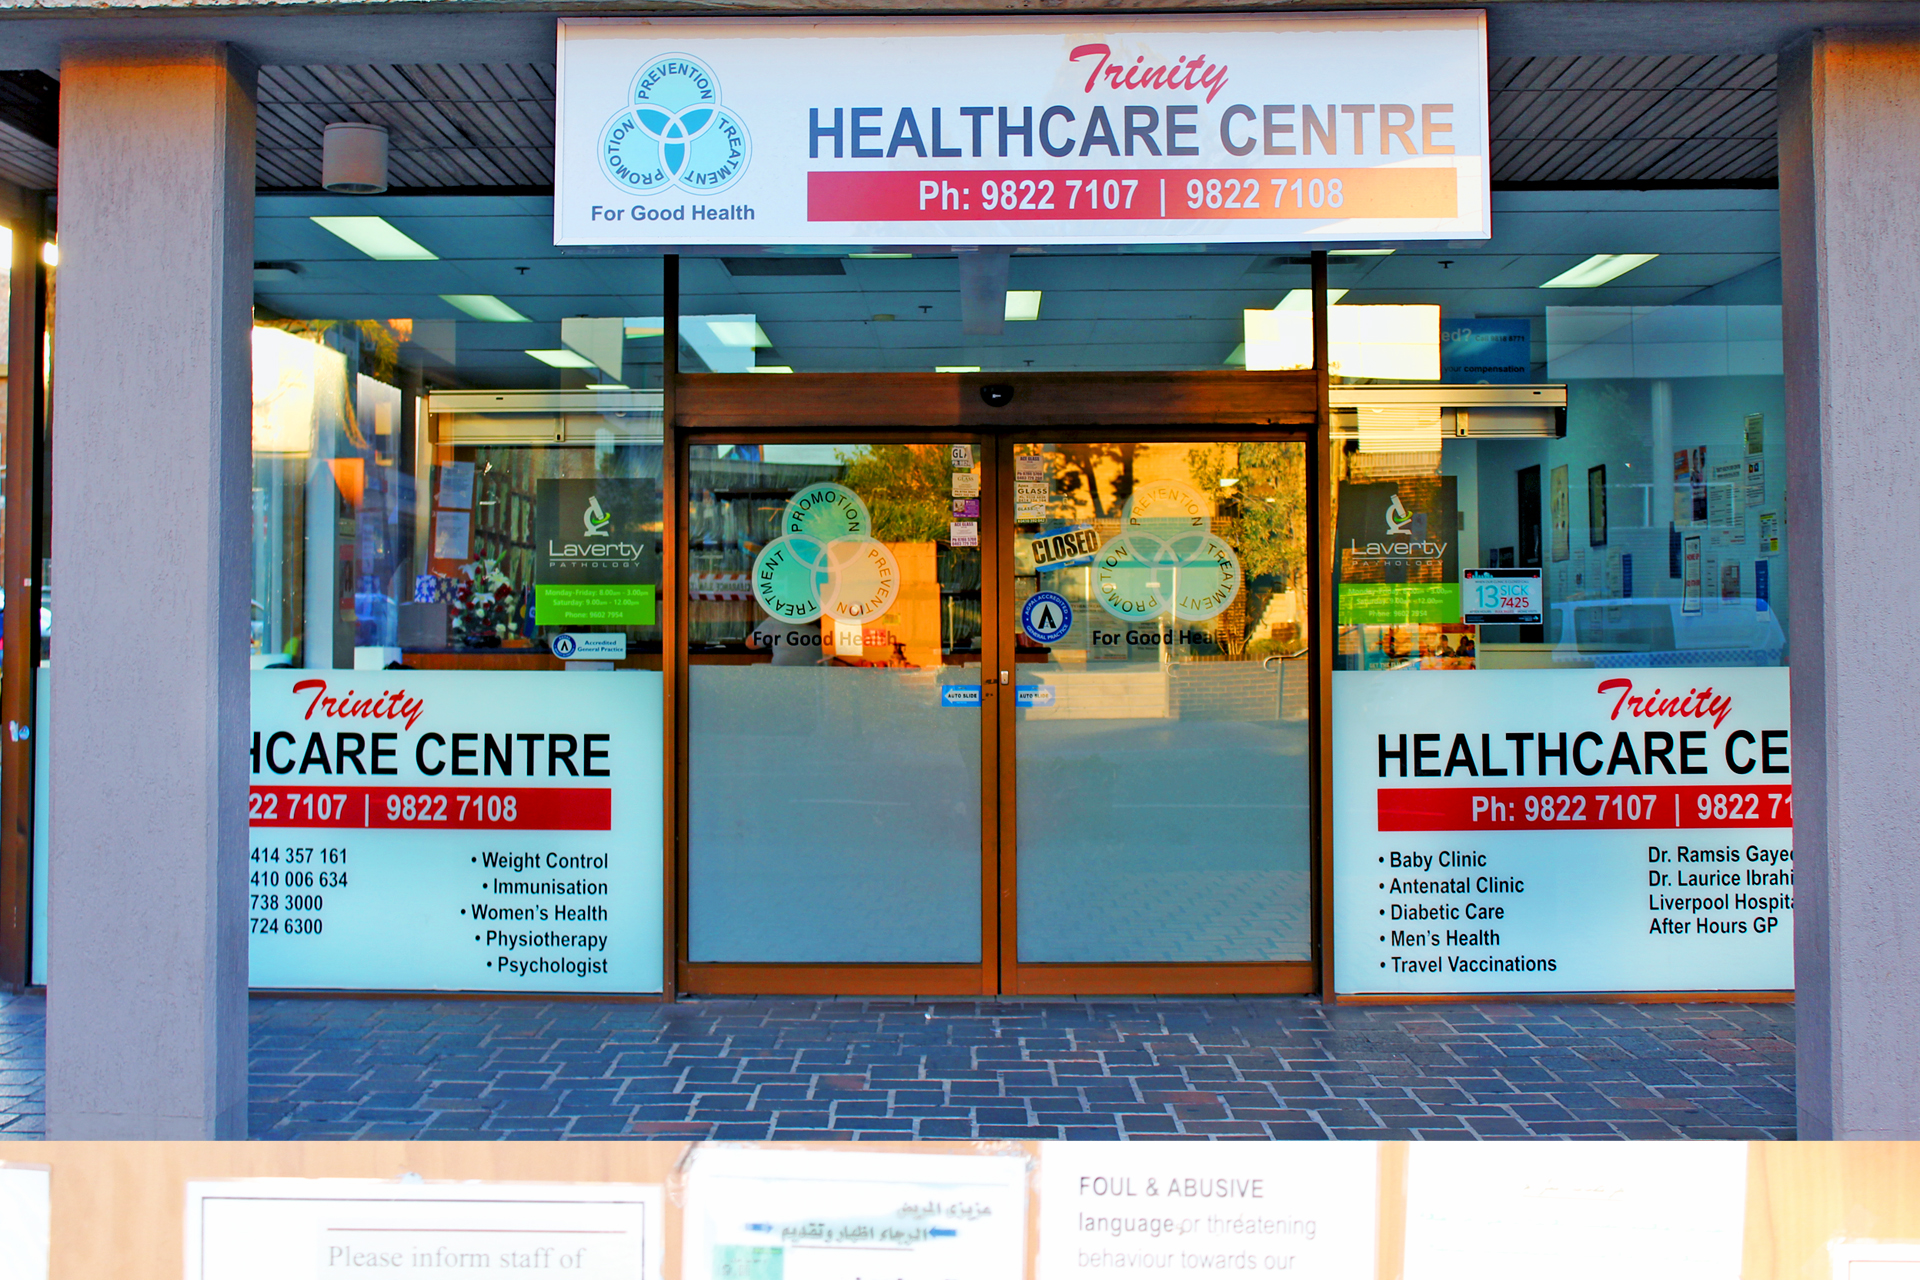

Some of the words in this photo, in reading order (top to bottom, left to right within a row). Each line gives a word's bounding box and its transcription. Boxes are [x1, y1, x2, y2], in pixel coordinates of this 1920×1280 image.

[638, 62, 713, 100] PREVENTION
[1069, 43, 1229, 104] Trinity
[809, 104, 1200, 159] HEALTHCARE
[1220, 103, 1455, 156] CENTRE
[607, 119, 665, 185] PROMOTION
[684, 117, 742, 185] TREATMENT
[919, 180, 970, 211] Ph:
[981, 179, 1055, 211] 9822
[1065, 179, 1139, 210] 7107
[1186, 178, 1260, 209] 9822
[1271, 177, 1344, 208] 7108
[591, 205, 625, 222] For
[631, 205, 685, 222] Good
[692, 204, 755, 222] Health
[1464, 365, 1525, 374] compensation
[792, 491, 859, 532] PROMOTION
[1130, 488, 1202, 526] PREVENTION
[549, 540, 644, 561] Laverty
[1032, 530, 1099, 565] CLOSED
[1352, 538, 1447, 559] Laverty
[760, 550, 817, 616] TREATMENT
[836, 549, 892, 616] PREVENTION
[1100, 546, 1158, 612] PROMOTION
[1180, 543, 1233, 610] TREATMENT
[1037, 593, 1069, 614] ACCREDITED
[1476, 585, 1499, 608] 13
[1501, 585, 1529, 596] SICK
[1501, 597, 1529, 608] 7425
[753, 632, 781, 646] For
[786, 632, 833, 646] Good
[1047, 624, 1068, 640] PRACTICE
[1092, 631, 1121, 645] For
[1126, 630, 1173, 645] Good
[1179, 630, 1222, 645] Heal
[293, 678, 424, 731] Trinity
[1597, 677, 1732, 730] Trinity
[415, 731, 611, 777] CENTRE
[1378, 730, 1708, 778] HEALTHCARE
[286, 793, 348, 821] 7107
[386, 794, 448, 821] 9822
[456, 794, 518, 822] 7108
[1472, 795, 1515, 822] Ph:
[1524, 794, 1587, 822] 9822
[1595, 794, 1657, 821] 7107
[1697, 793, 1759, 819] 9822
[251, 847, 280, 863] 414
[285, 847, 313, 863] 357
[320, 848, 347, 864] 161
[482, 851, 541, 873] Weight
[546, 851, 608, 869] Control
[1390, 851, 1433, 872] Baby
[1438, 850, 1487, 868] Clinic
[1648, 846, 1671, 863] Dr.
[1677, 845, 1741, 863] Ramsis
[251, 870, 279, 887] 410
[285, 871, 313, 887] 006
[320, 871, 347, 887] 634
[494, 877, 608, 895] Immunisation
[1389, 876, 1470, 894] Antenatal
[1476, 876, 1524, 894] Clinic
[1649, 870, 1672, 886] Dr.
[1678, 869, 1741, 887] Laurice
[251, 894, 279, 910] 738
[285, 895, 323, 911] 3000
[471, 902, 549, 921] Women's
[554, 903, 609, 922] Health
[1390, 903, 1460, 921] Diabetic
[1465, 902, 1505, 920] Care
[1649, 893, 1729, 914] Liverpool
[250, 918, 278, 933] 724
[285, 918, 322, 934] 6300
[1649, 917, 1691, 934] After
[1696, 917, 1748, 933] Hours
[1753, 916, 1778, 933] GP
[486, 929, 608, 952] Physiotherapy
[1391, 929, 1440, 947] Men's
[1446, 929, 1501, 946] Health
[498, 956, 608, 978] Psychologist
[1391, 956, 1442, 973] Travel
[1447, 954, 1557, 973] Vaccinations
[1080, 1176, 1137, 1197] FOUL
[1145, 1177, 1159, 1197] &
[1167, 1178, 1264, 1198] ABUSIVE
[1079, 1212, 1174, 1237] language
[1181, 1218, 1200, 1234] or
[1207, 1214, 1316, 1240] threatening
[328, 1246, 404, 1267] Please
[412, 1246, 491, 1268] inform
[500, 1247, 555, 1269] staff
[560, 1248, 588, 1269] of
[1078, 1248, 1174, 1268] behaviour
[1181, 1249, 1257, 1269] towards
[1264, 1254, 1296, 1270] our
